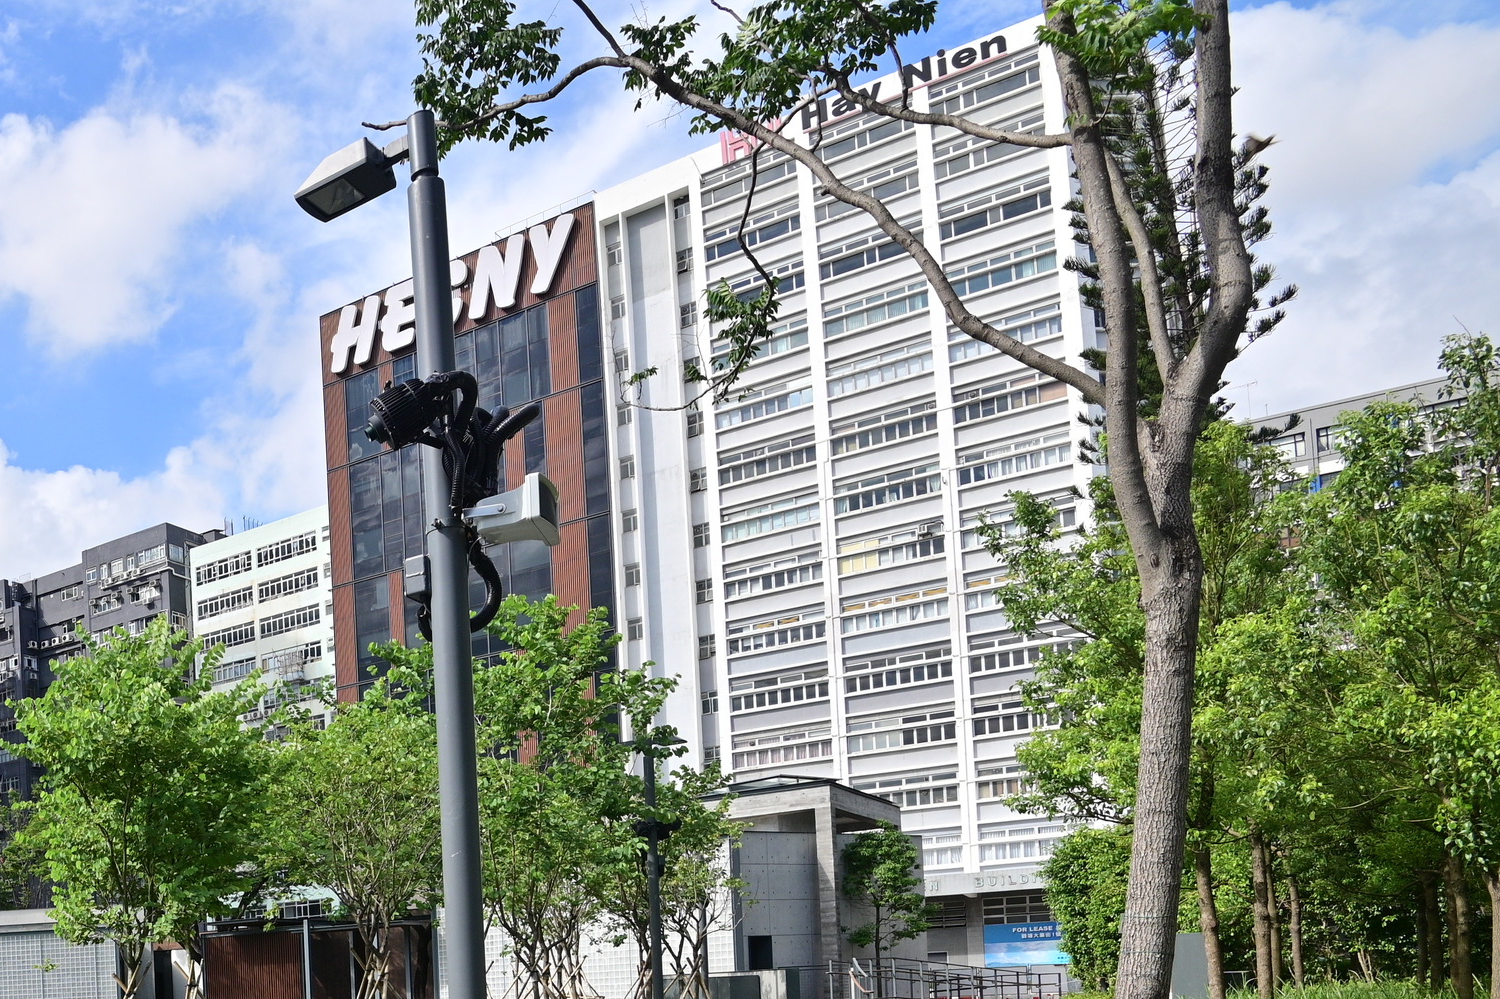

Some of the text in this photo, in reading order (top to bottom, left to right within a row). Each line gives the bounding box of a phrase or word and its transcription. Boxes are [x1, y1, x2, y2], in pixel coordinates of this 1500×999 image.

[801, 33, 1008, 130] Hay Nien
[975, 873, 1046, 888] BUILDI
